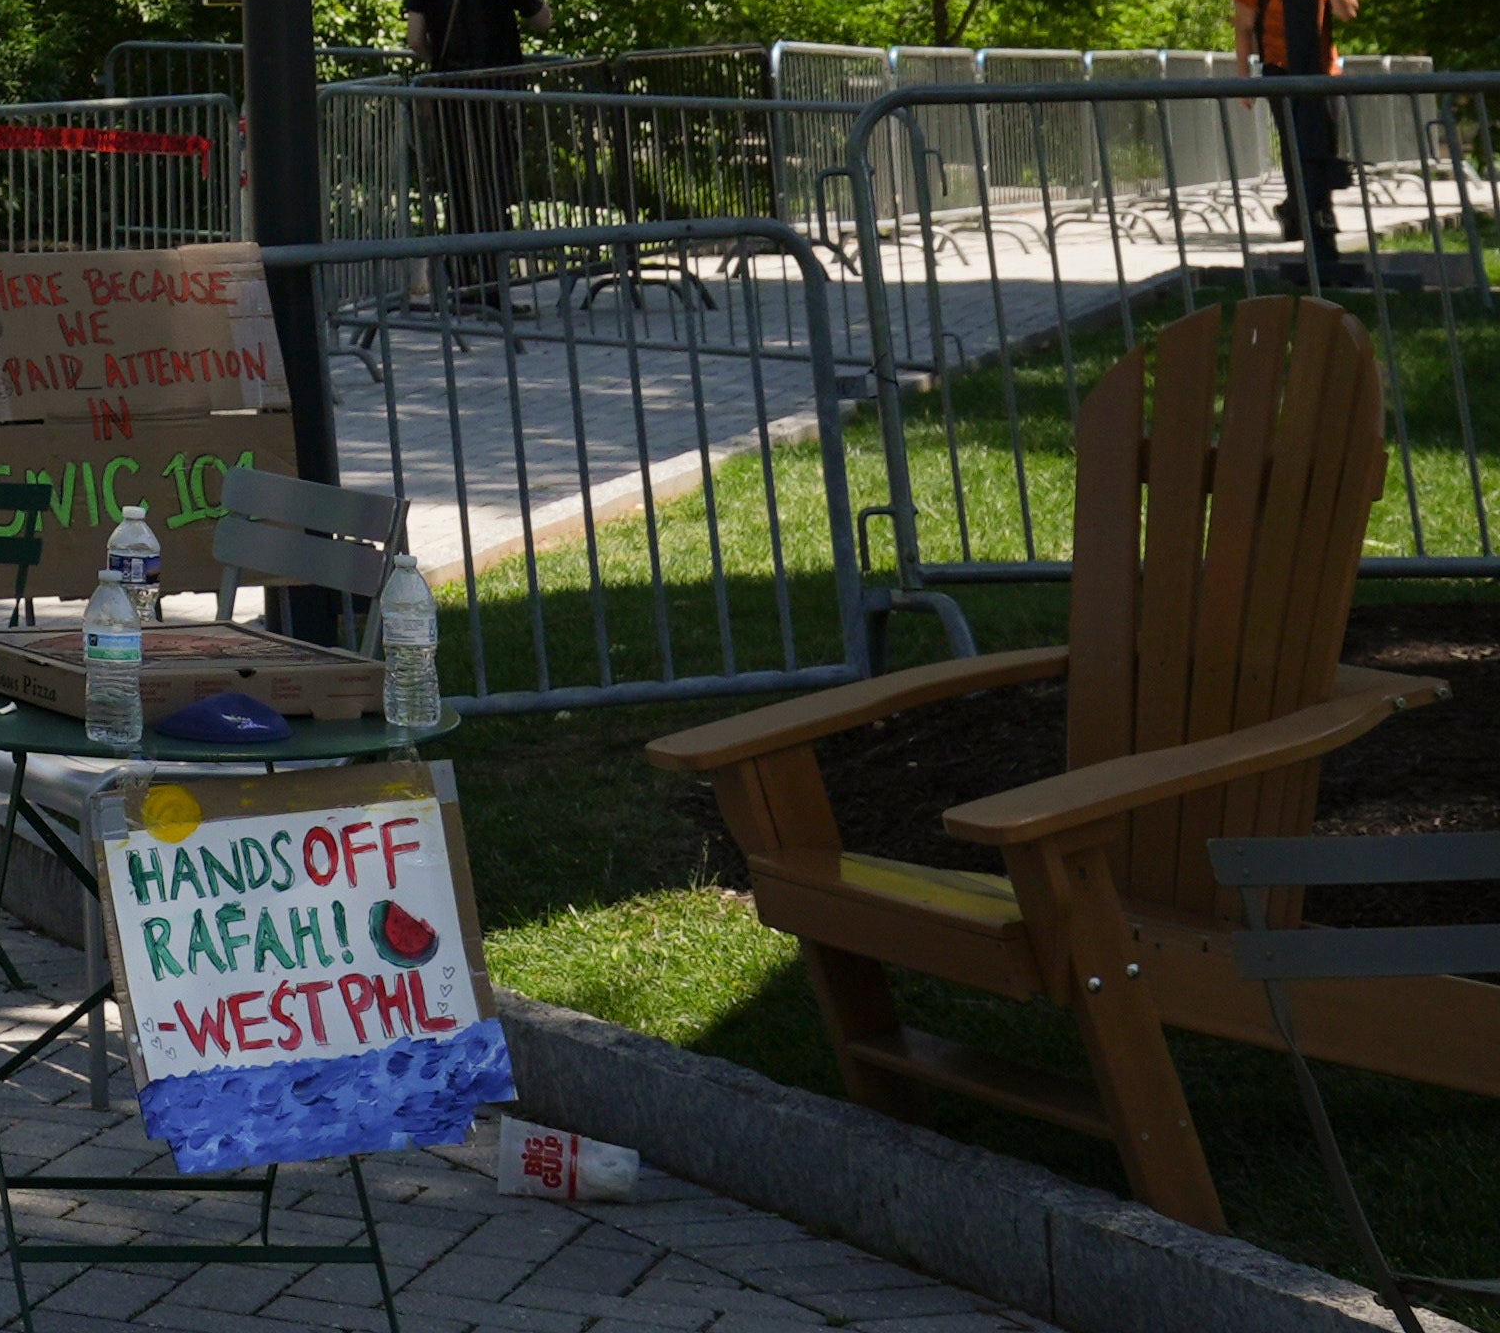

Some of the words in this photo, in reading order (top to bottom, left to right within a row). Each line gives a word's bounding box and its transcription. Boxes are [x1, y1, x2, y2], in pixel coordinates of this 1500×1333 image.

[82, 267, 237, 306] BECAUSE
[58, 310, 114, 347] WE
[2, 353, 83, 396] PAID
[106, 343, 266, 388] ATTENTION
[88, 396, 134, 441] IN
[22, 678, 58, 704] Pizza
[125, 830, 295, 905] HANDS
[303, 816, 421, 889] OFF
[141, 900, 354, 982] RAFAH!
[338, 970, 463, 1045] PHL
[542, 1135, 564, 1189] GULP
